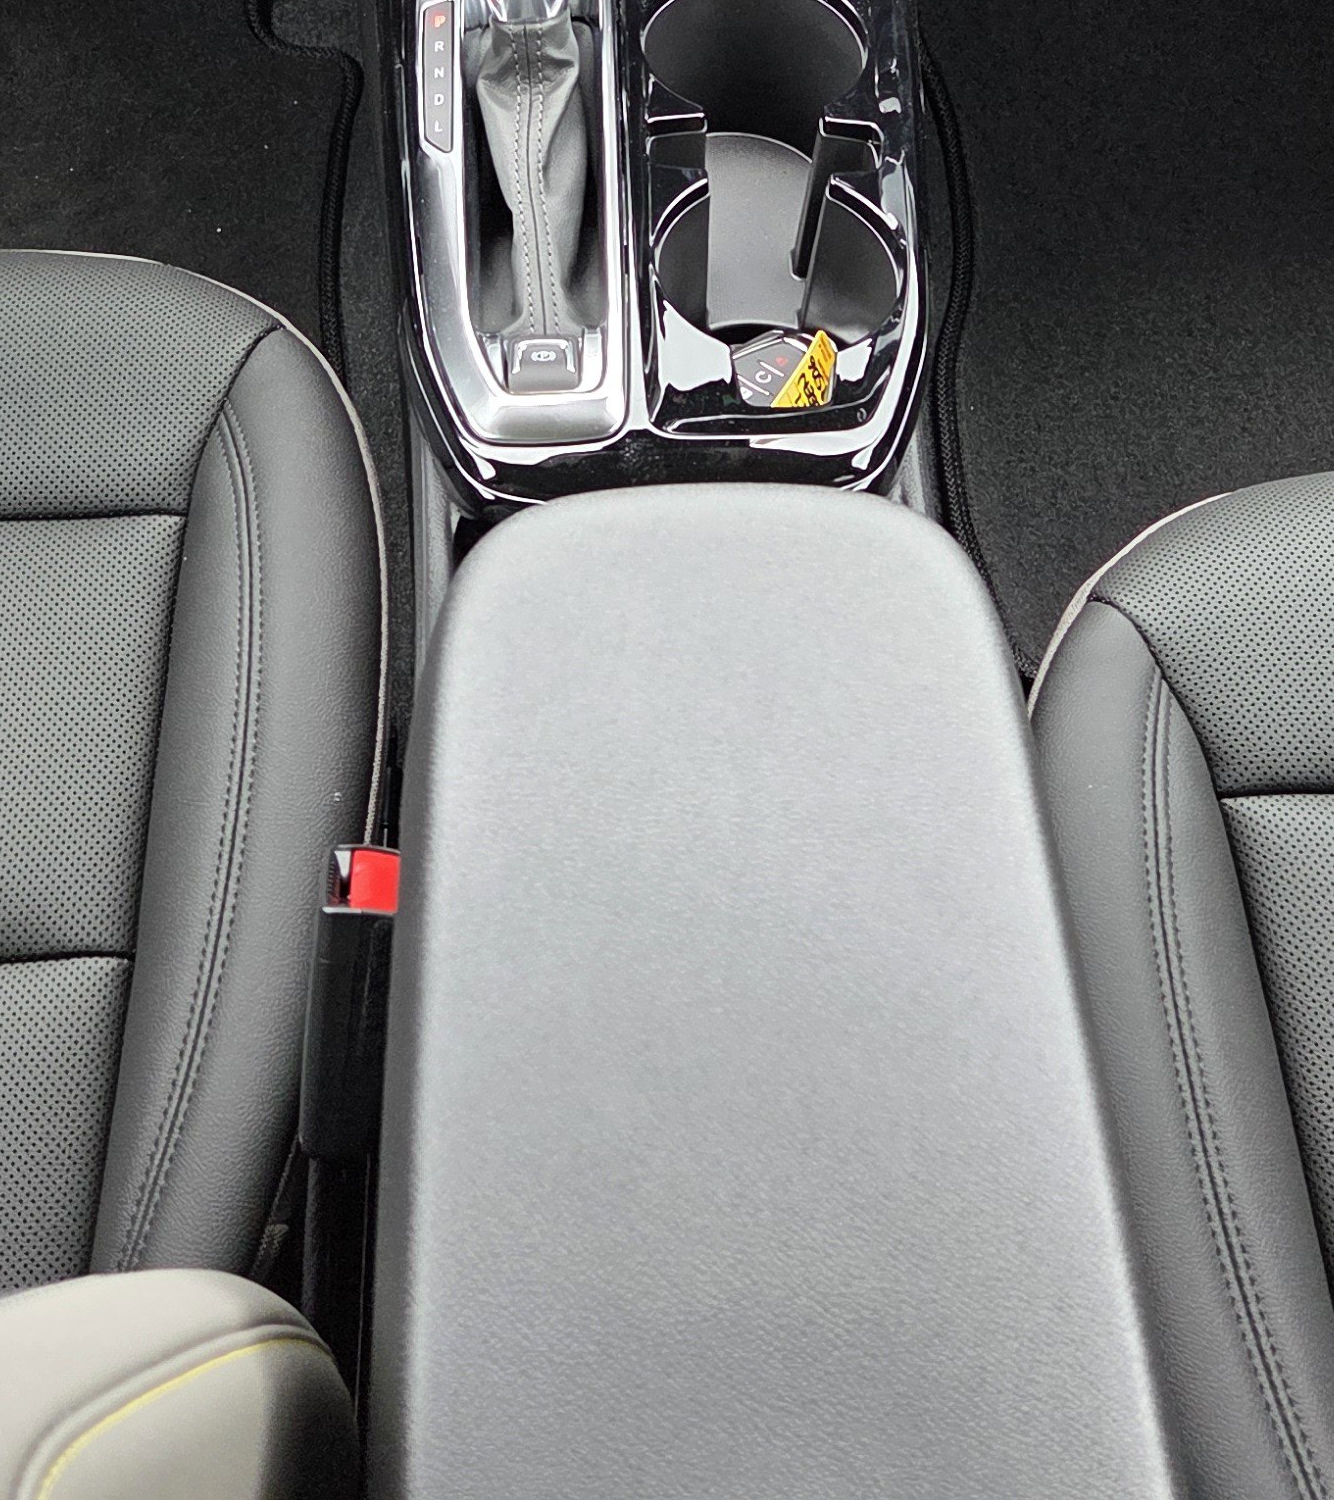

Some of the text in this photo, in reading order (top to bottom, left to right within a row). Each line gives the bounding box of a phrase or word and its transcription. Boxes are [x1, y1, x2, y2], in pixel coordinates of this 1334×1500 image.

[434, 15, 447, 133] P R N D L
